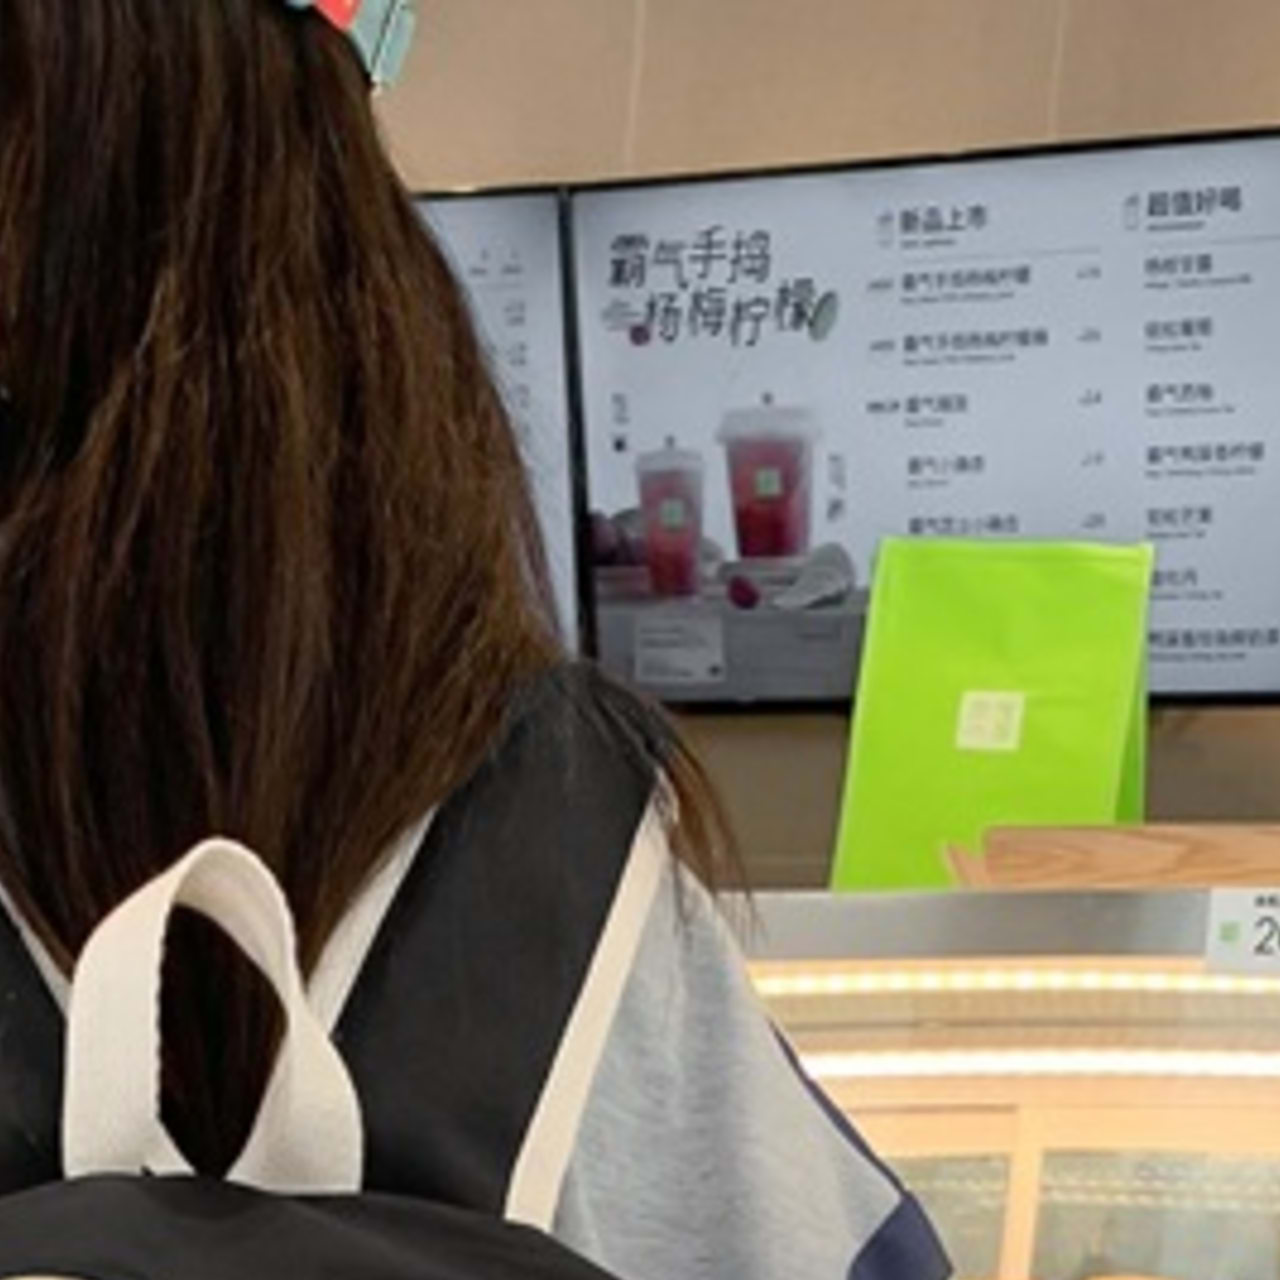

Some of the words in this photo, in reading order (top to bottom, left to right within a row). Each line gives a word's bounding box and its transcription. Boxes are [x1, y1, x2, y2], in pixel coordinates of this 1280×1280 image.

[900, 204, 988, 234] 新品上市
[1146, 185, 1242, 217] 超值好喝
[609, 226, 771, 290] 霸气手捣
[642, 276, 816, 347] 杨梅柠檬
